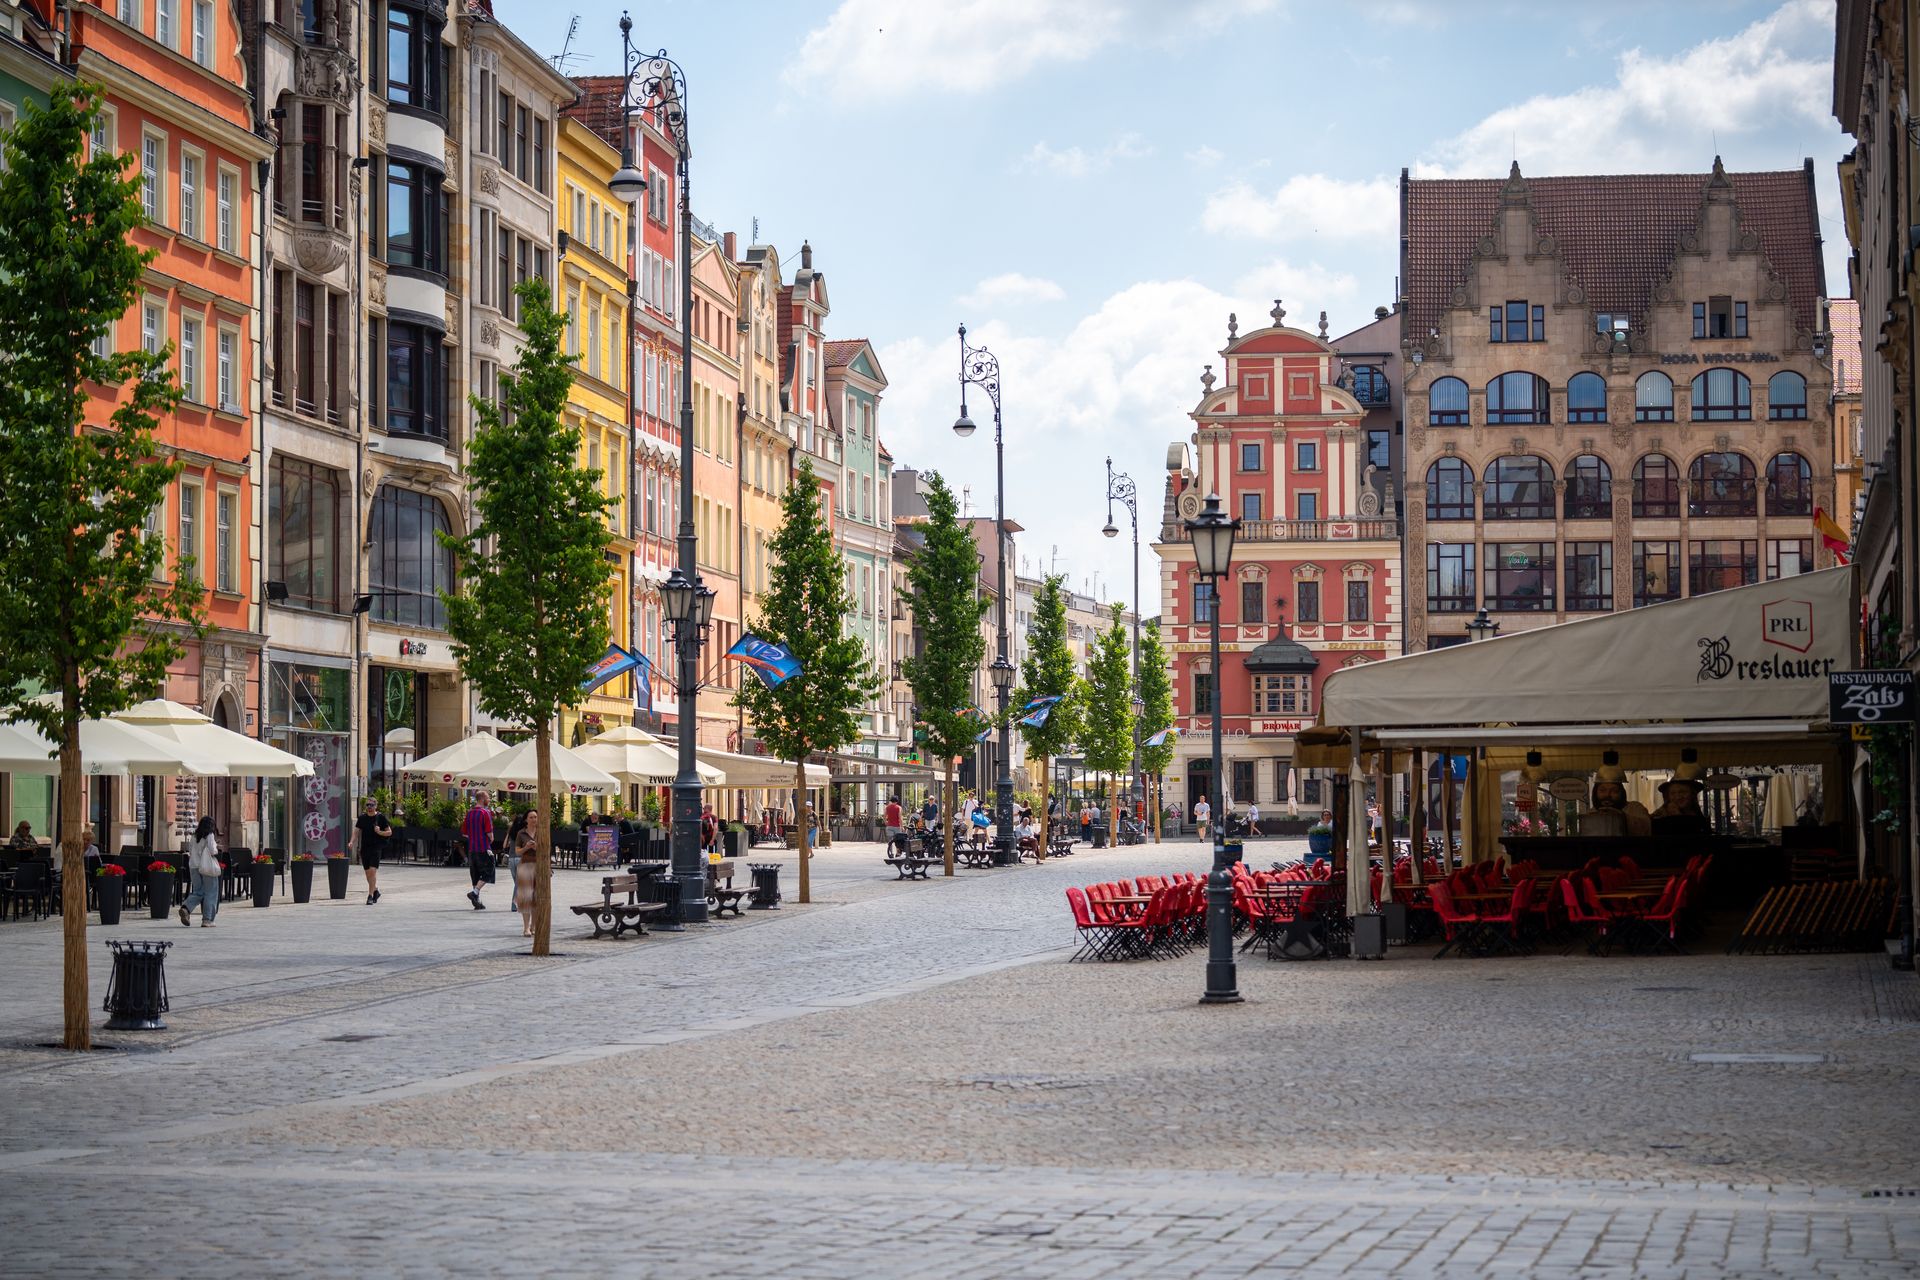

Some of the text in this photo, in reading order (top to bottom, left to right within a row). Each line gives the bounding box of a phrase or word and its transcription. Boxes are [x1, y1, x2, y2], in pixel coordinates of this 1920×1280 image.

[1660, 353, 1699, 365] MODA
[1770, 617, 1808, 633] PRL
[1172, 643, 1240, 651] MINI BRWAR
[1697, 635, 1835, 684] Breslauer
[1830, 672, 1913, 686] RESTAURACJA
